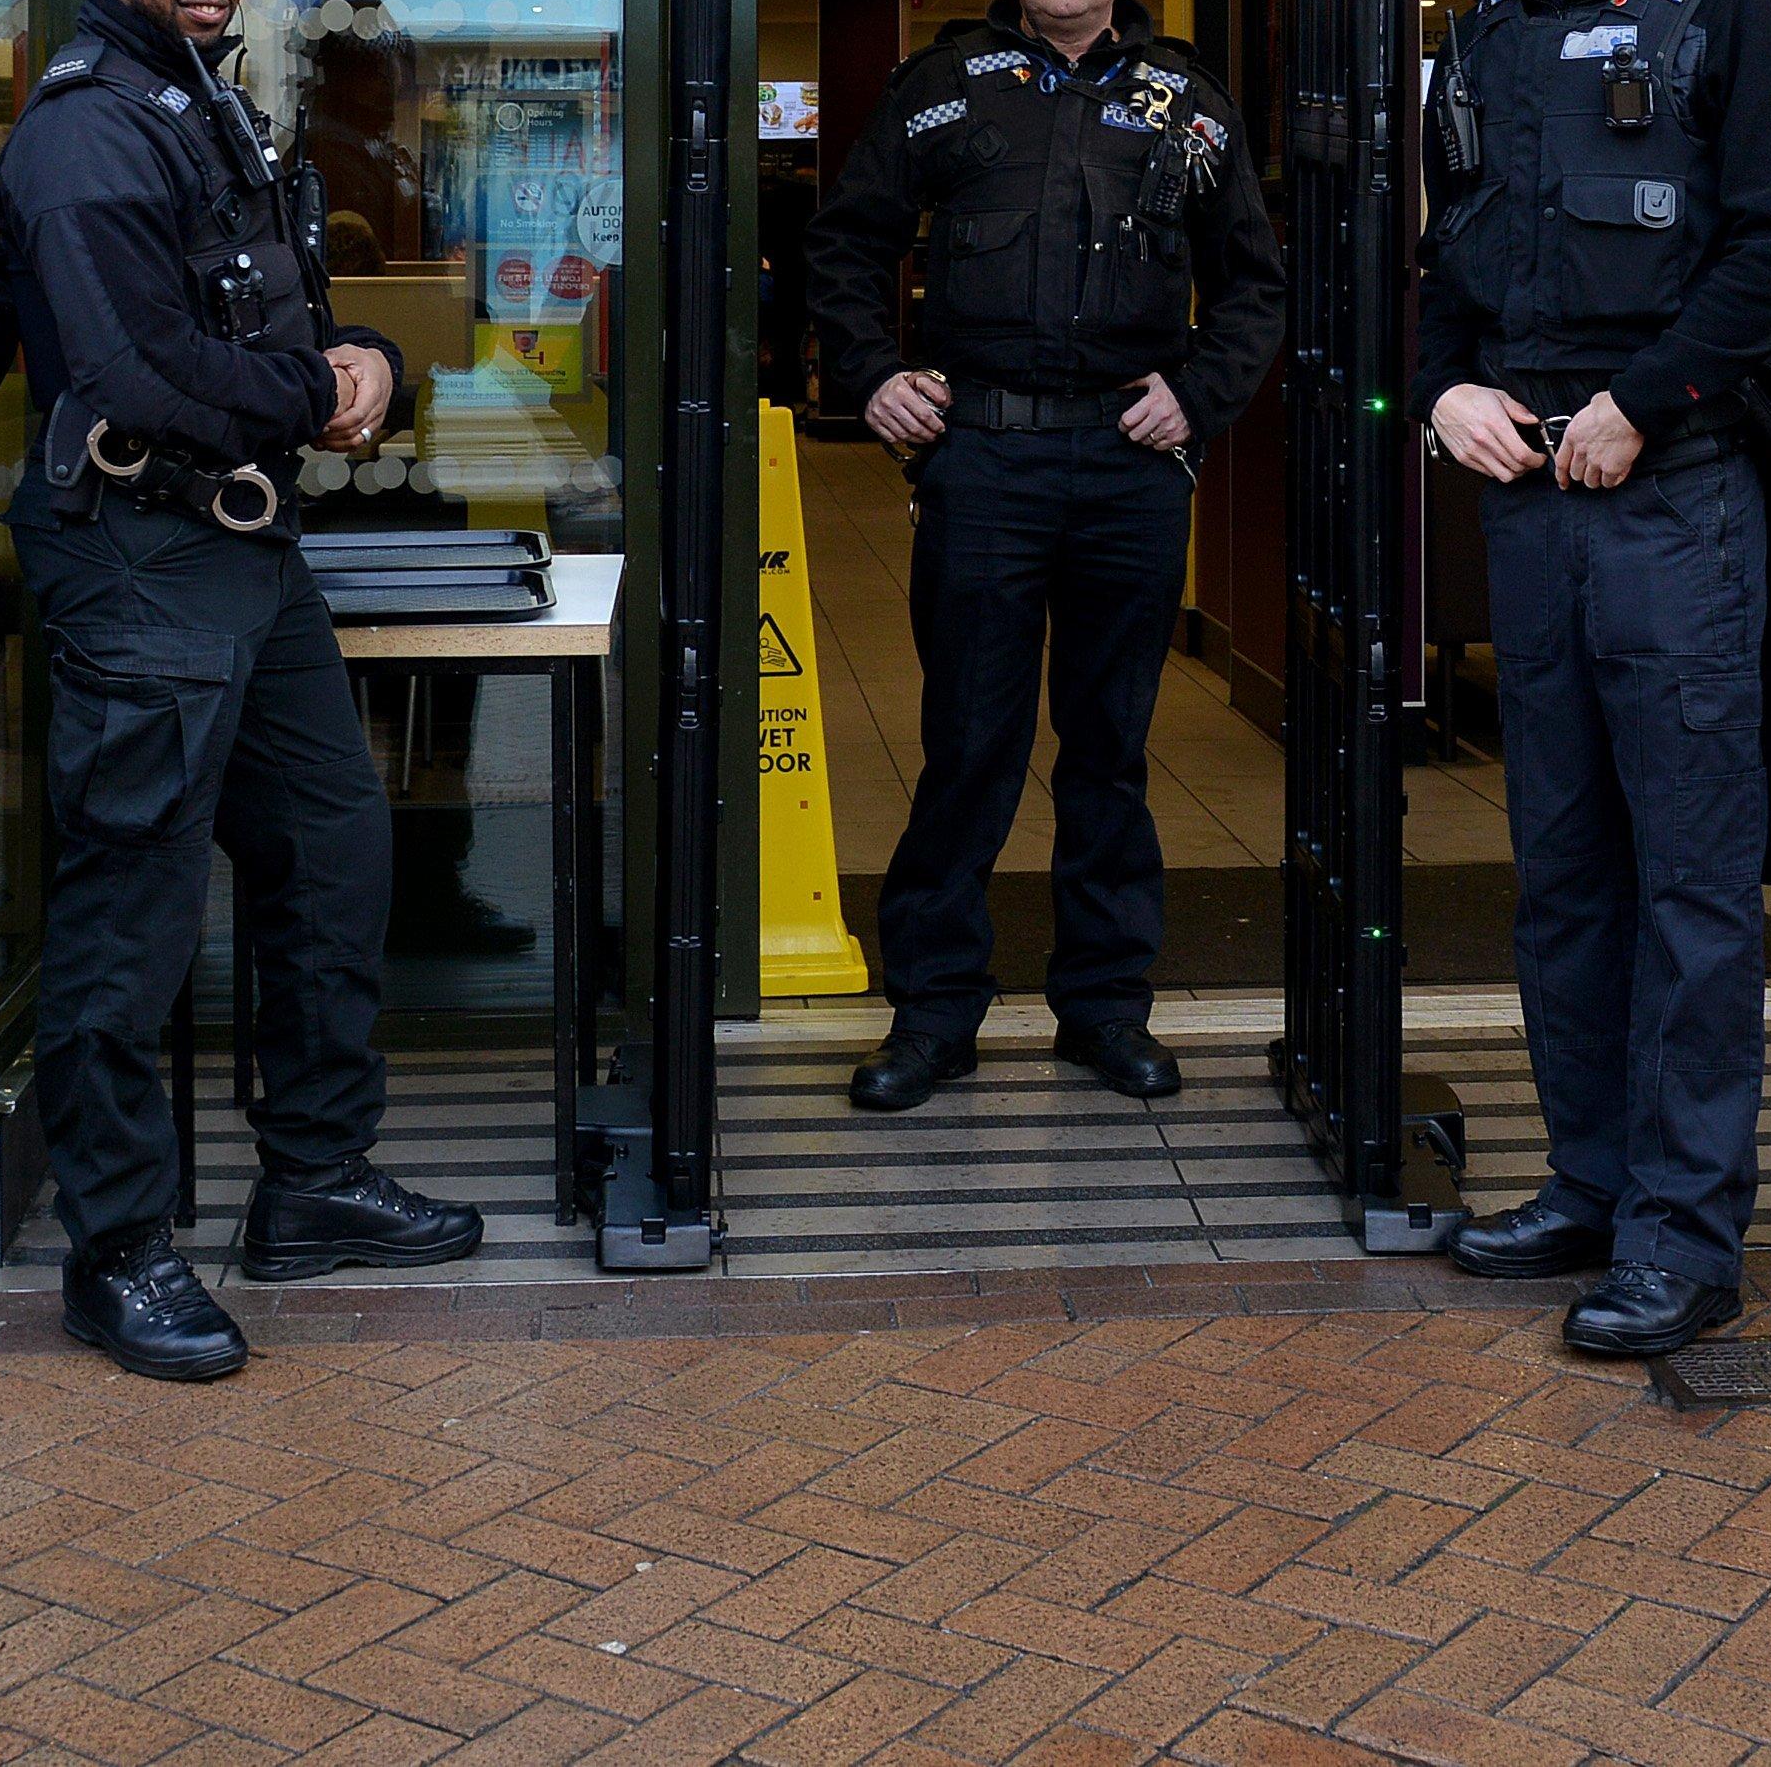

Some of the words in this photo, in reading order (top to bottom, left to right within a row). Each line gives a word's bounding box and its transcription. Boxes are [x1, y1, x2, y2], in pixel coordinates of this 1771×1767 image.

[527, 108, 564, 119] Opening
[500, 220, 514, 228] No
[516, 220, 558, 230] Smoking
[593, 233, 620, 243] Keep
[759, 753, 812, 774] OOR
